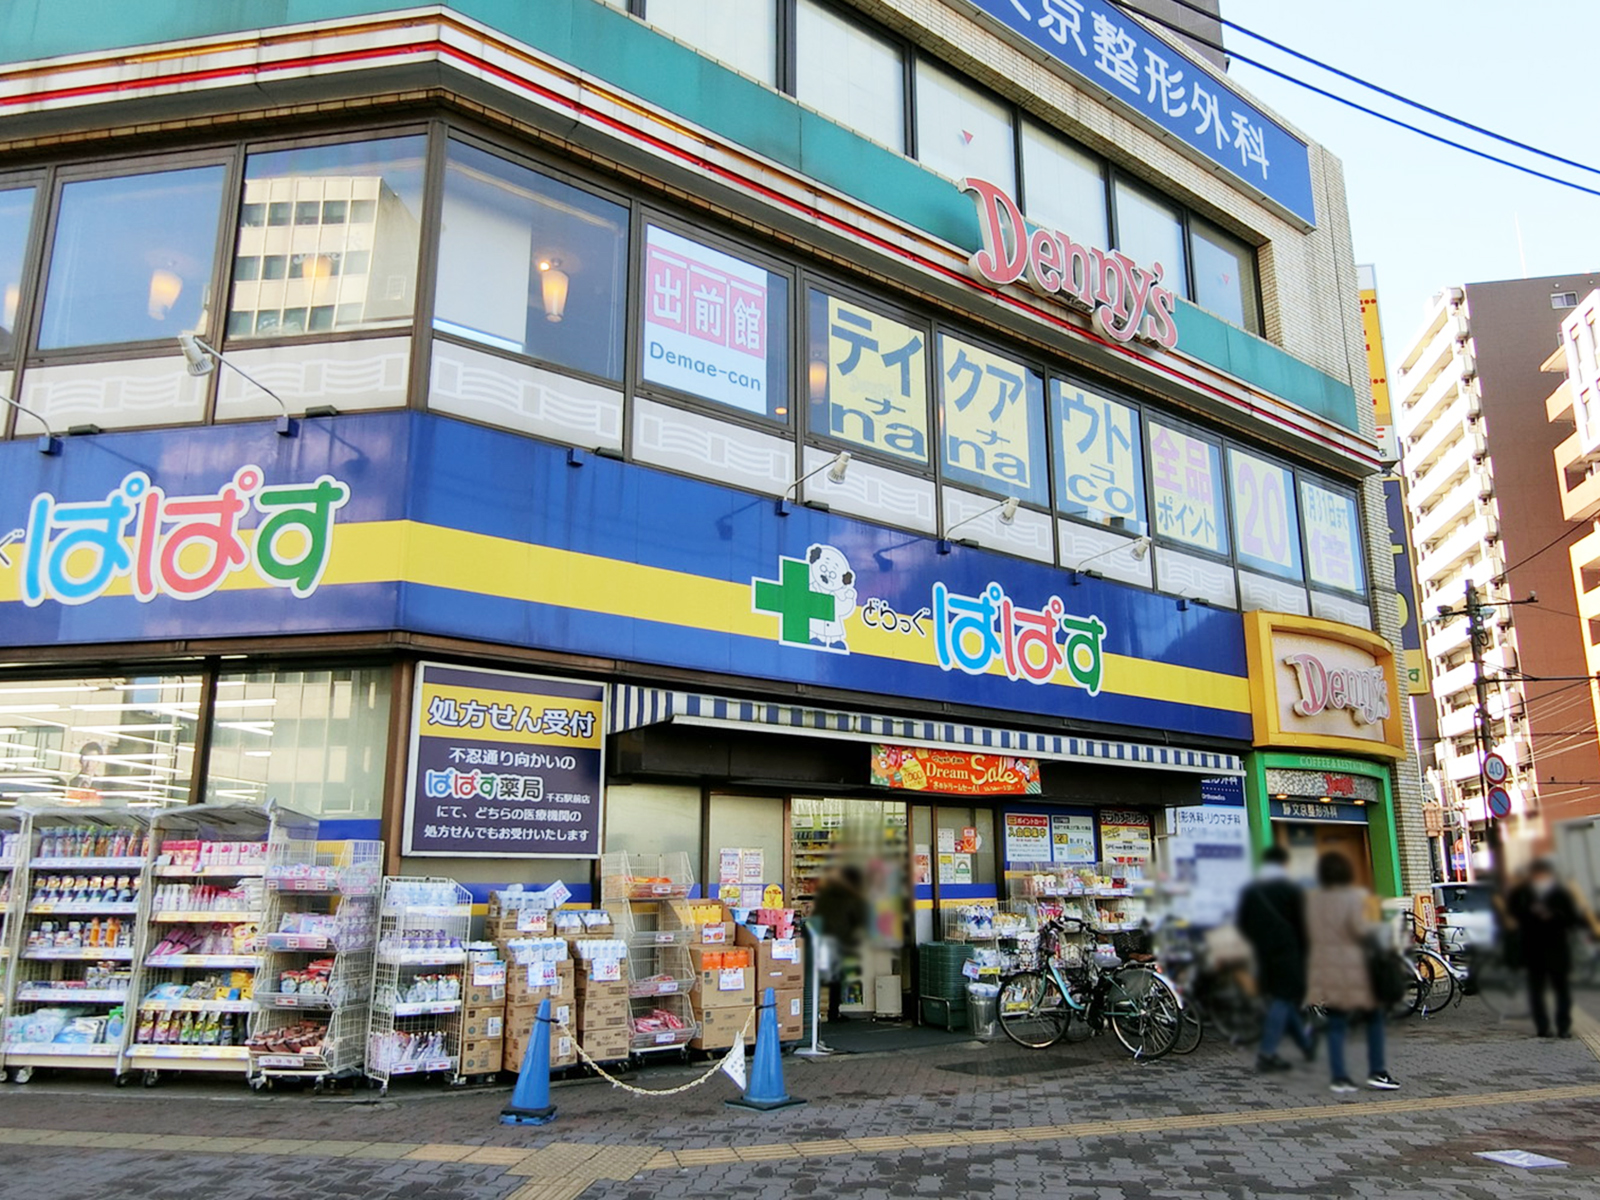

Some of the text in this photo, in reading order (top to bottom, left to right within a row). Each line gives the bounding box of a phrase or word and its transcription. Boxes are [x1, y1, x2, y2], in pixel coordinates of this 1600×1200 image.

[1009, 0, 1269, 181] 京整形外科
[959, 178, 1178, 351] Denny's
[652, 266, 762, 351] 出前館
[649, 341, 761, 391] Demae-can
[831, 402, 925, 457] na
[949, 434, 1029, 485] na
[1151, 427, 1212, 506] 全品
[1067, 473, 1134, 515] co
[1157, 495, 1215, 543] ポイント
[1238, 462, 1287, 562] 20
[24, 466, 348, 605] ぱぱす
[862, 582, 1106, 697] どらっぐ ぱぱす
[1284, 654, 1390, 724] Denny's
[428, 696, 595, 738] 処方せん受付
[449, 747, 576, 770] 不忍通り向かいの
[926, 754, 1018, 785] Dream Sale
[1489, 762, 1503, 776] 40
[425, 767, 543, 801] ぱぱす薬局
[424, 825, 589, 842] 処方せんでもお受けいたします
[436, 806, 582, 822] にて、どちらの医療機関の
